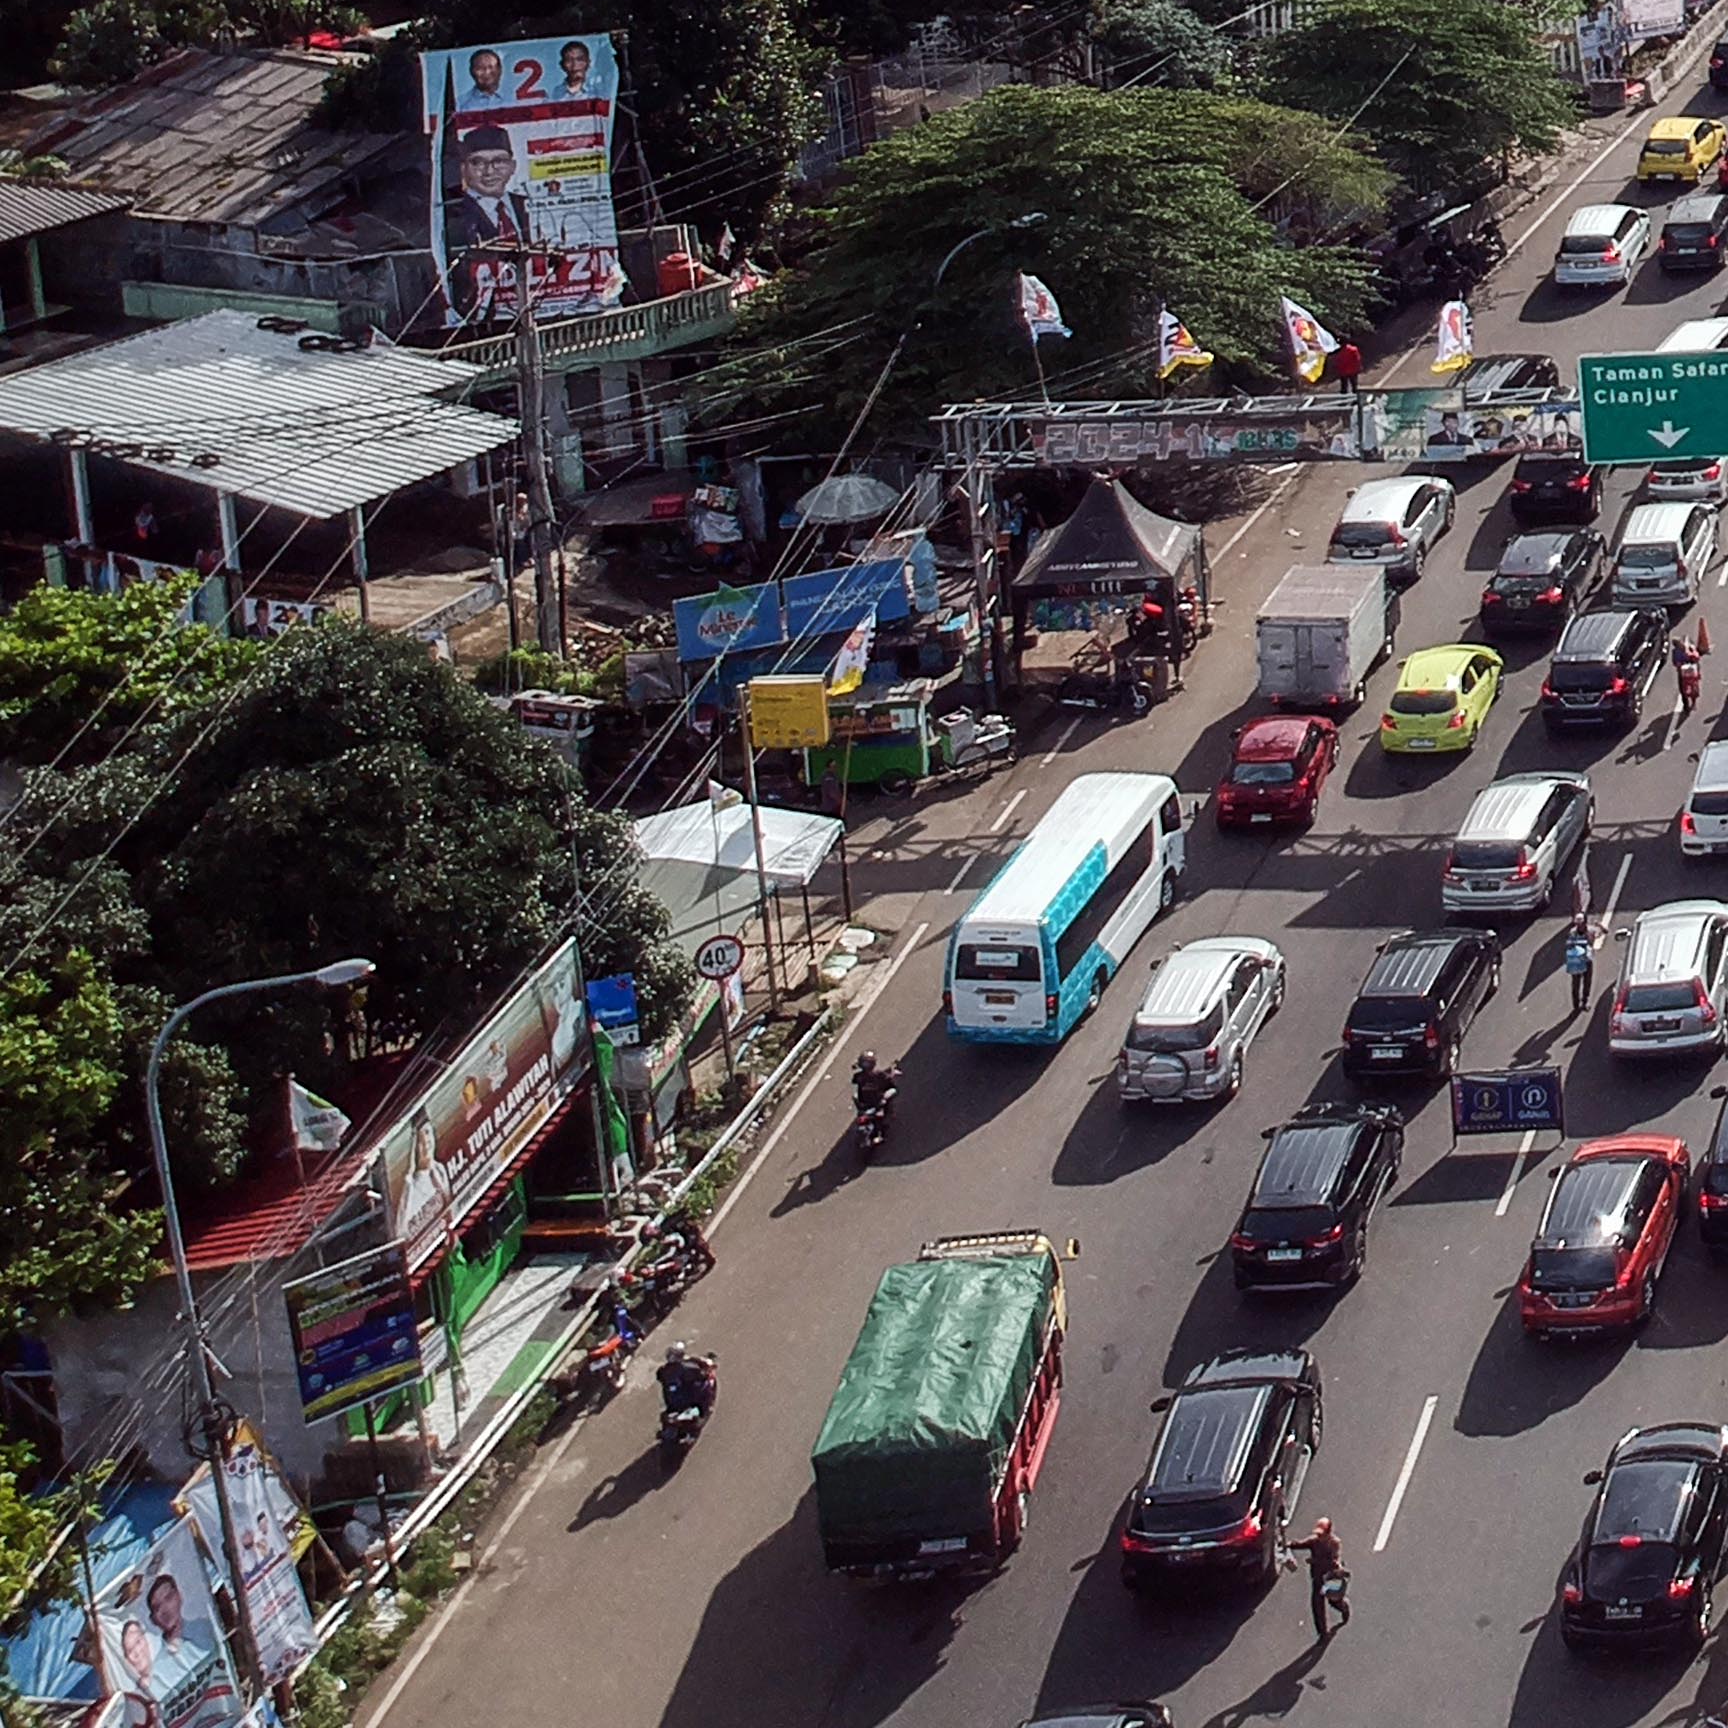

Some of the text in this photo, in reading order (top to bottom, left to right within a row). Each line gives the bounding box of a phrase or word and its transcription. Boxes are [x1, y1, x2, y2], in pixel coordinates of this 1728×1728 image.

[513, 59, 547, 100] 2
[1592, 365, 1665, 382] Taman
[1594, 387, 1678, 407] Cianjur
[702, 947, 726, 969] 40
[467, 1117, 494, 1154] TUTI
[494, 1054, 550, 1127] ALAWIYAH
